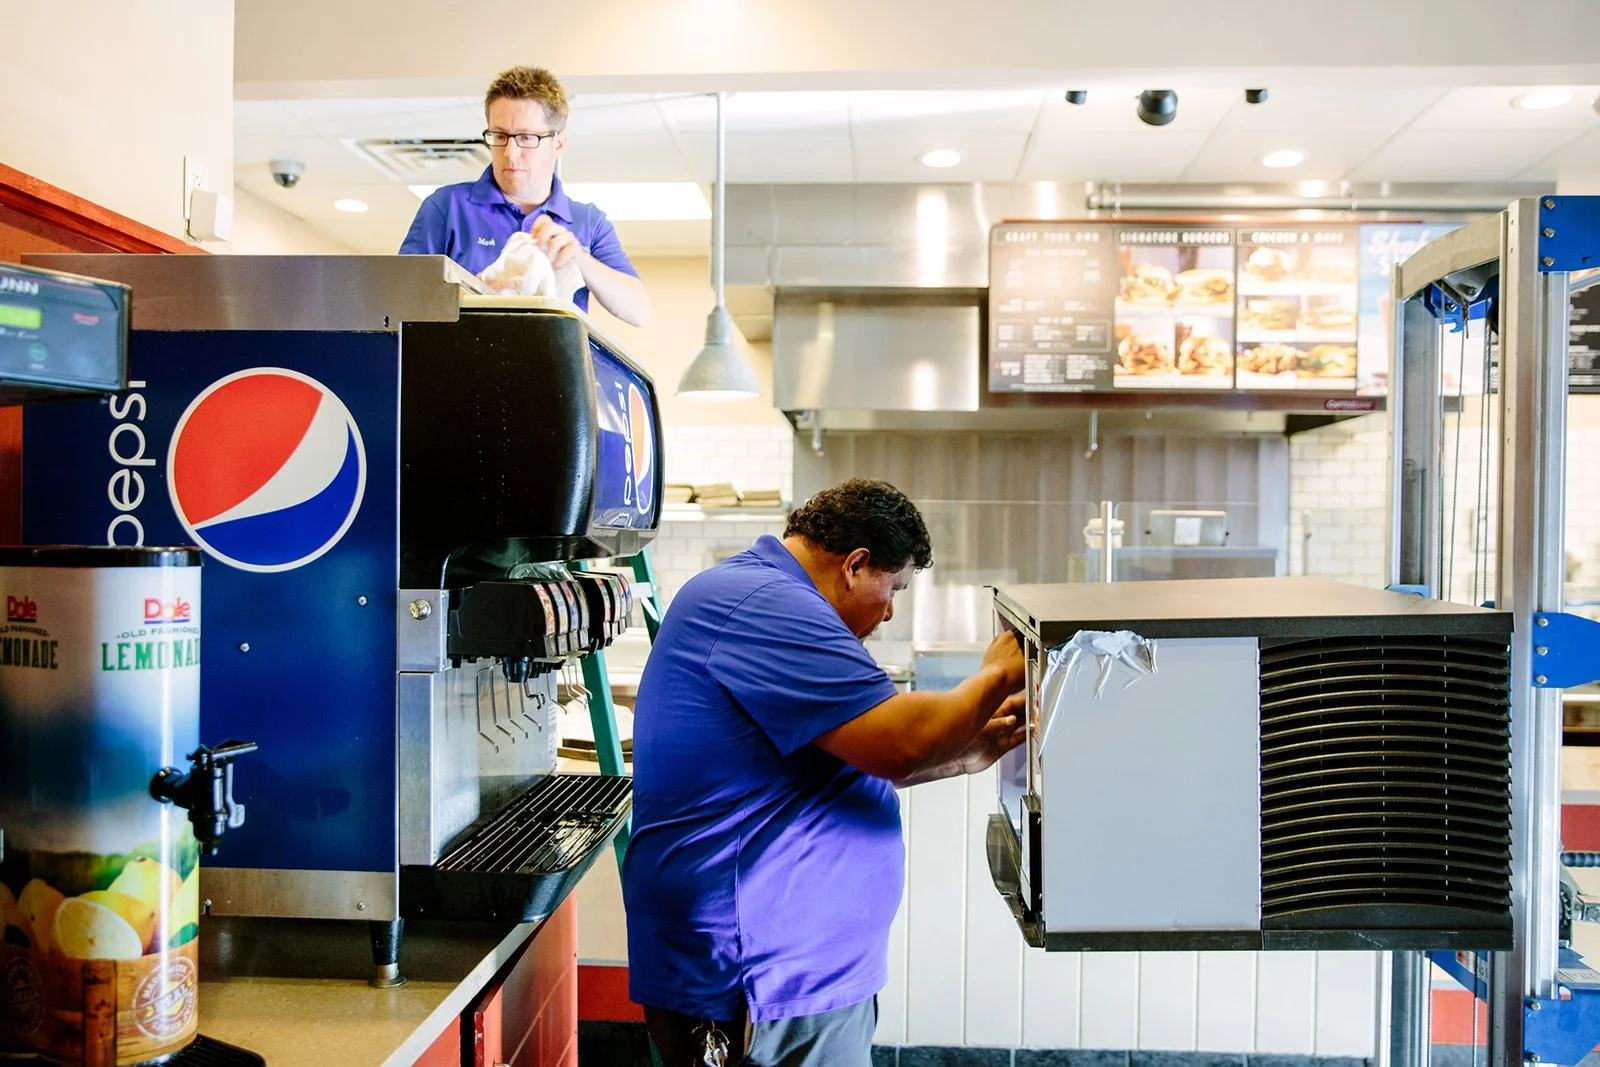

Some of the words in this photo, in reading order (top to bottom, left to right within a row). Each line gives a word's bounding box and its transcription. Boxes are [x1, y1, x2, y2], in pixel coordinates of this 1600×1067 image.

[615, 380, 632, 506] pepsi
[7, 595, 38, 618] Dole
[121, 629, 147, 639] OLD
